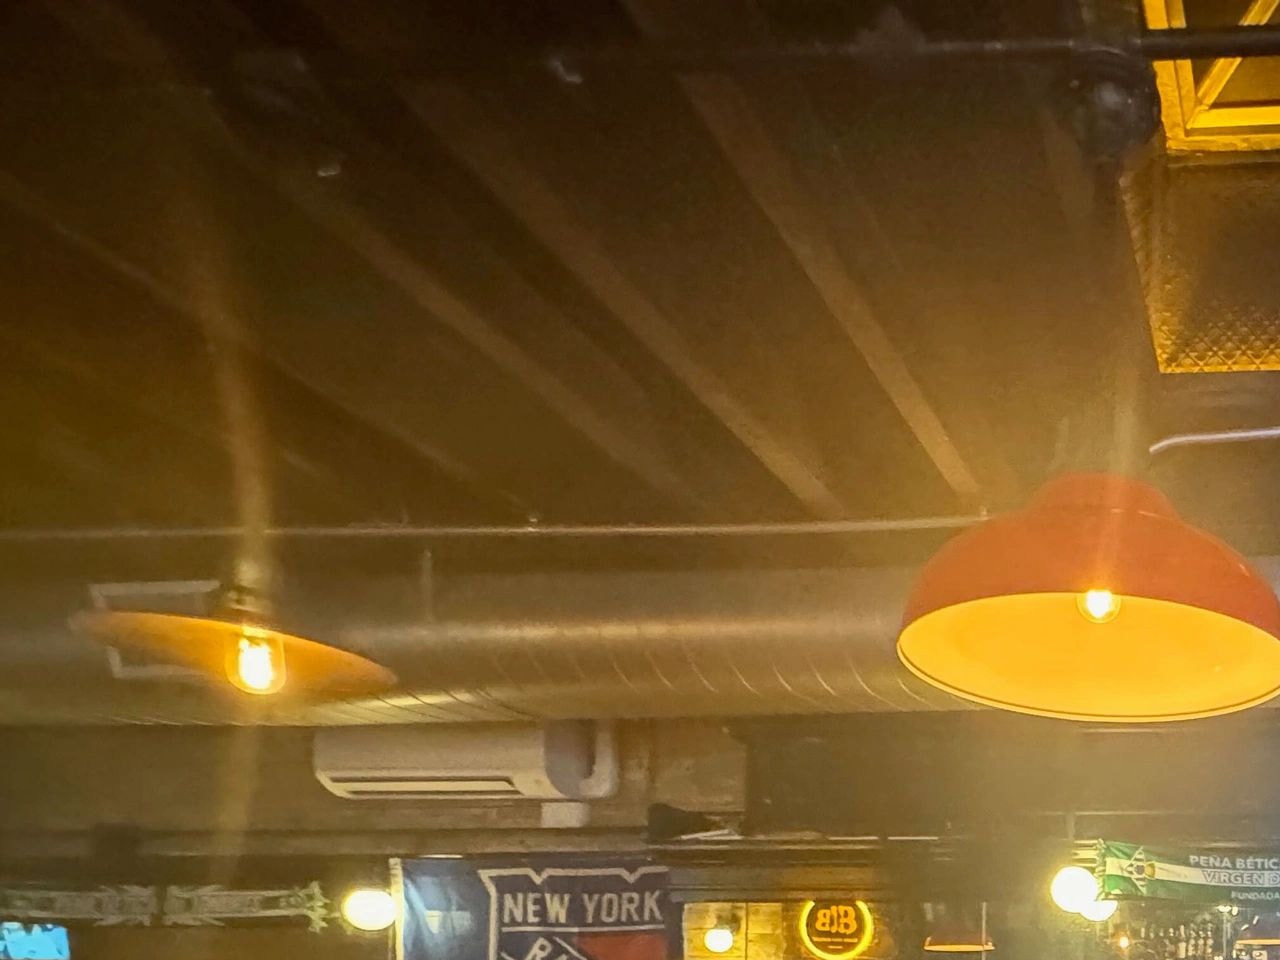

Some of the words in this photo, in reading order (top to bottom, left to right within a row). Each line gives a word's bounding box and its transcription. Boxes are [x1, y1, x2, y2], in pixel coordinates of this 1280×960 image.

[1203, 869, 1265, 885] VIRGEN
[503, 891, 570, 924] NEW
[583, 889, 664, 924] YORK
